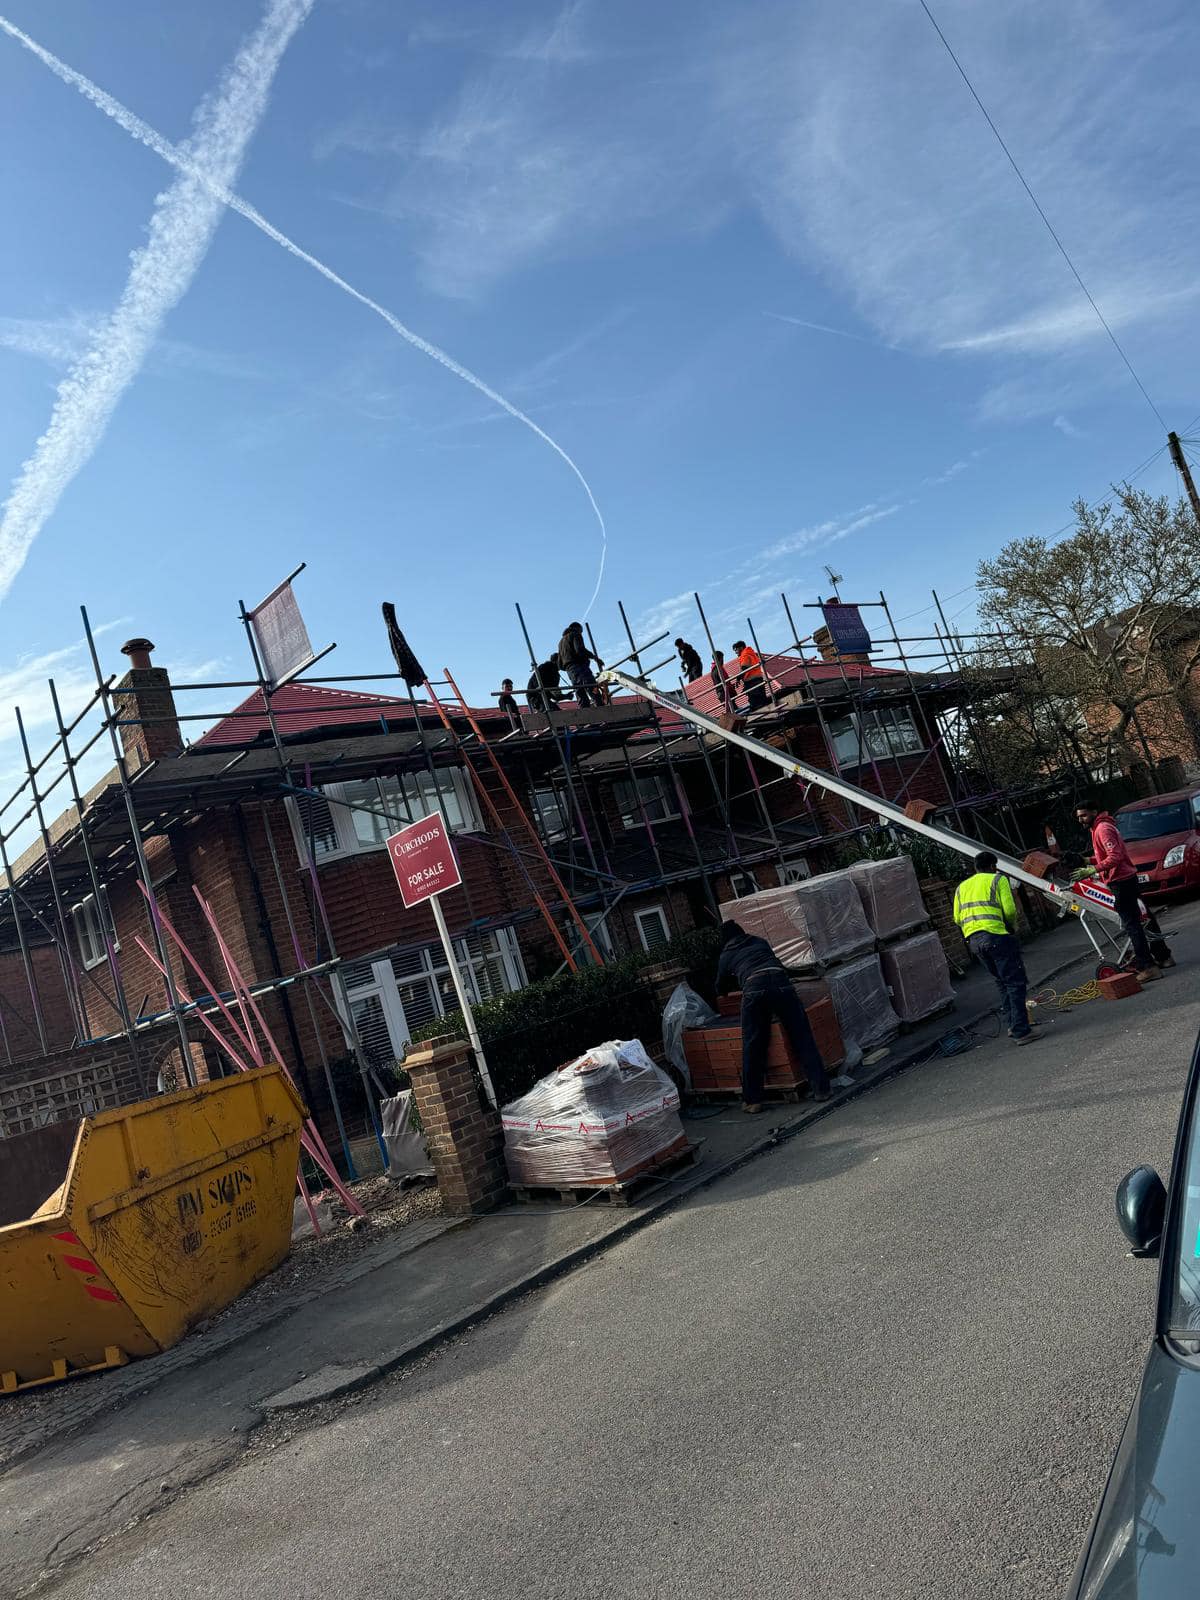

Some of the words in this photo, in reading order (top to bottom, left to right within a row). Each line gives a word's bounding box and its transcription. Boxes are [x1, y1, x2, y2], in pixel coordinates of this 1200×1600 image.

[408, 872, 423, 887] FOR
[423, 862, 445, 880] SALE
[208, 1165, 252, 1209] SKIPS
